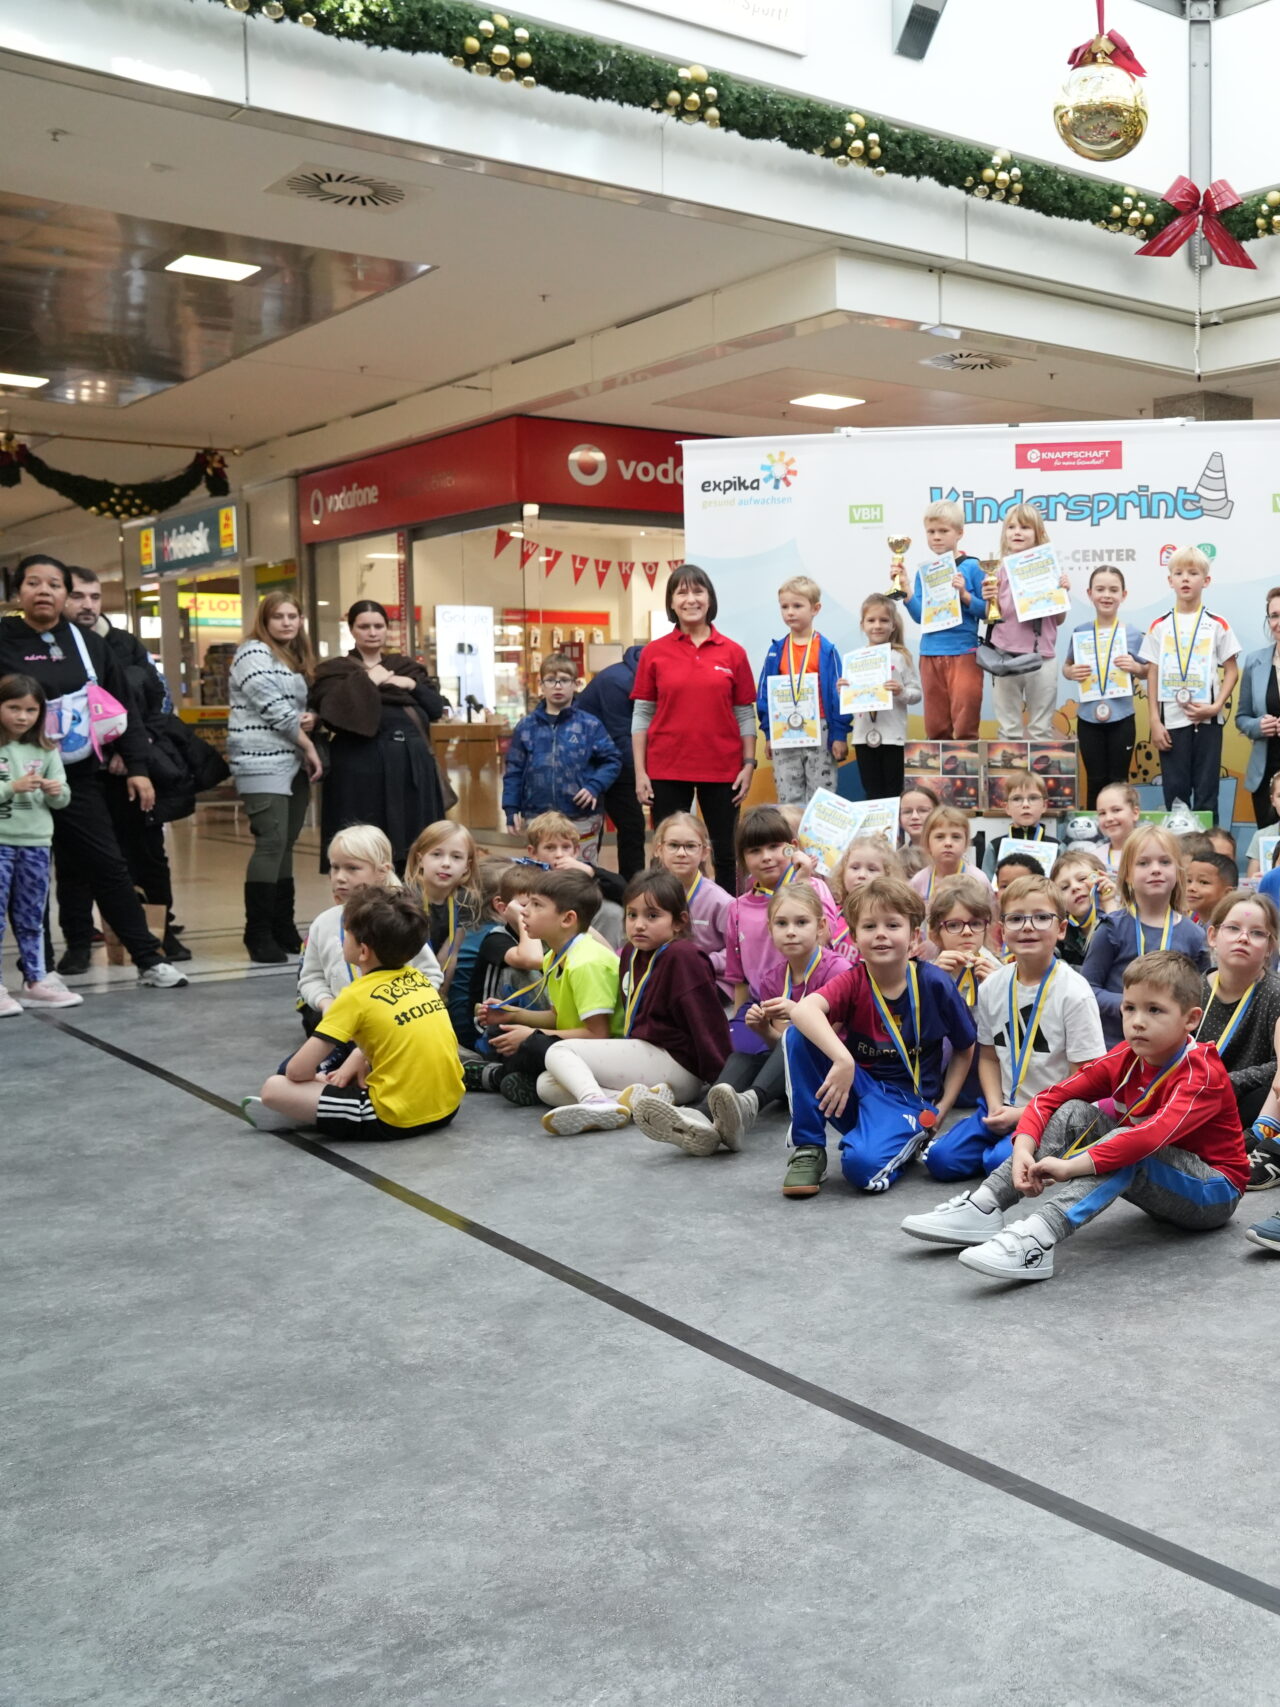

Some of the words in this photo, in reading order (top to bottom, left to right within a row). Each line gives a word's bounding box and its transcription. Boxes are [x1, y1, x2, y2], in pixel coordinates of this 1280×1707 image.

[1041, 450, 1111, 459] KNAPPSCHAFT
[701, 476, 760, 495] expika
[325, 483, 379, 513] vodafone
[702, 498, 735, 509] gesund
[738, 495, 792, 507] aufwachsen
[852, 507, 881, 520] VBH
